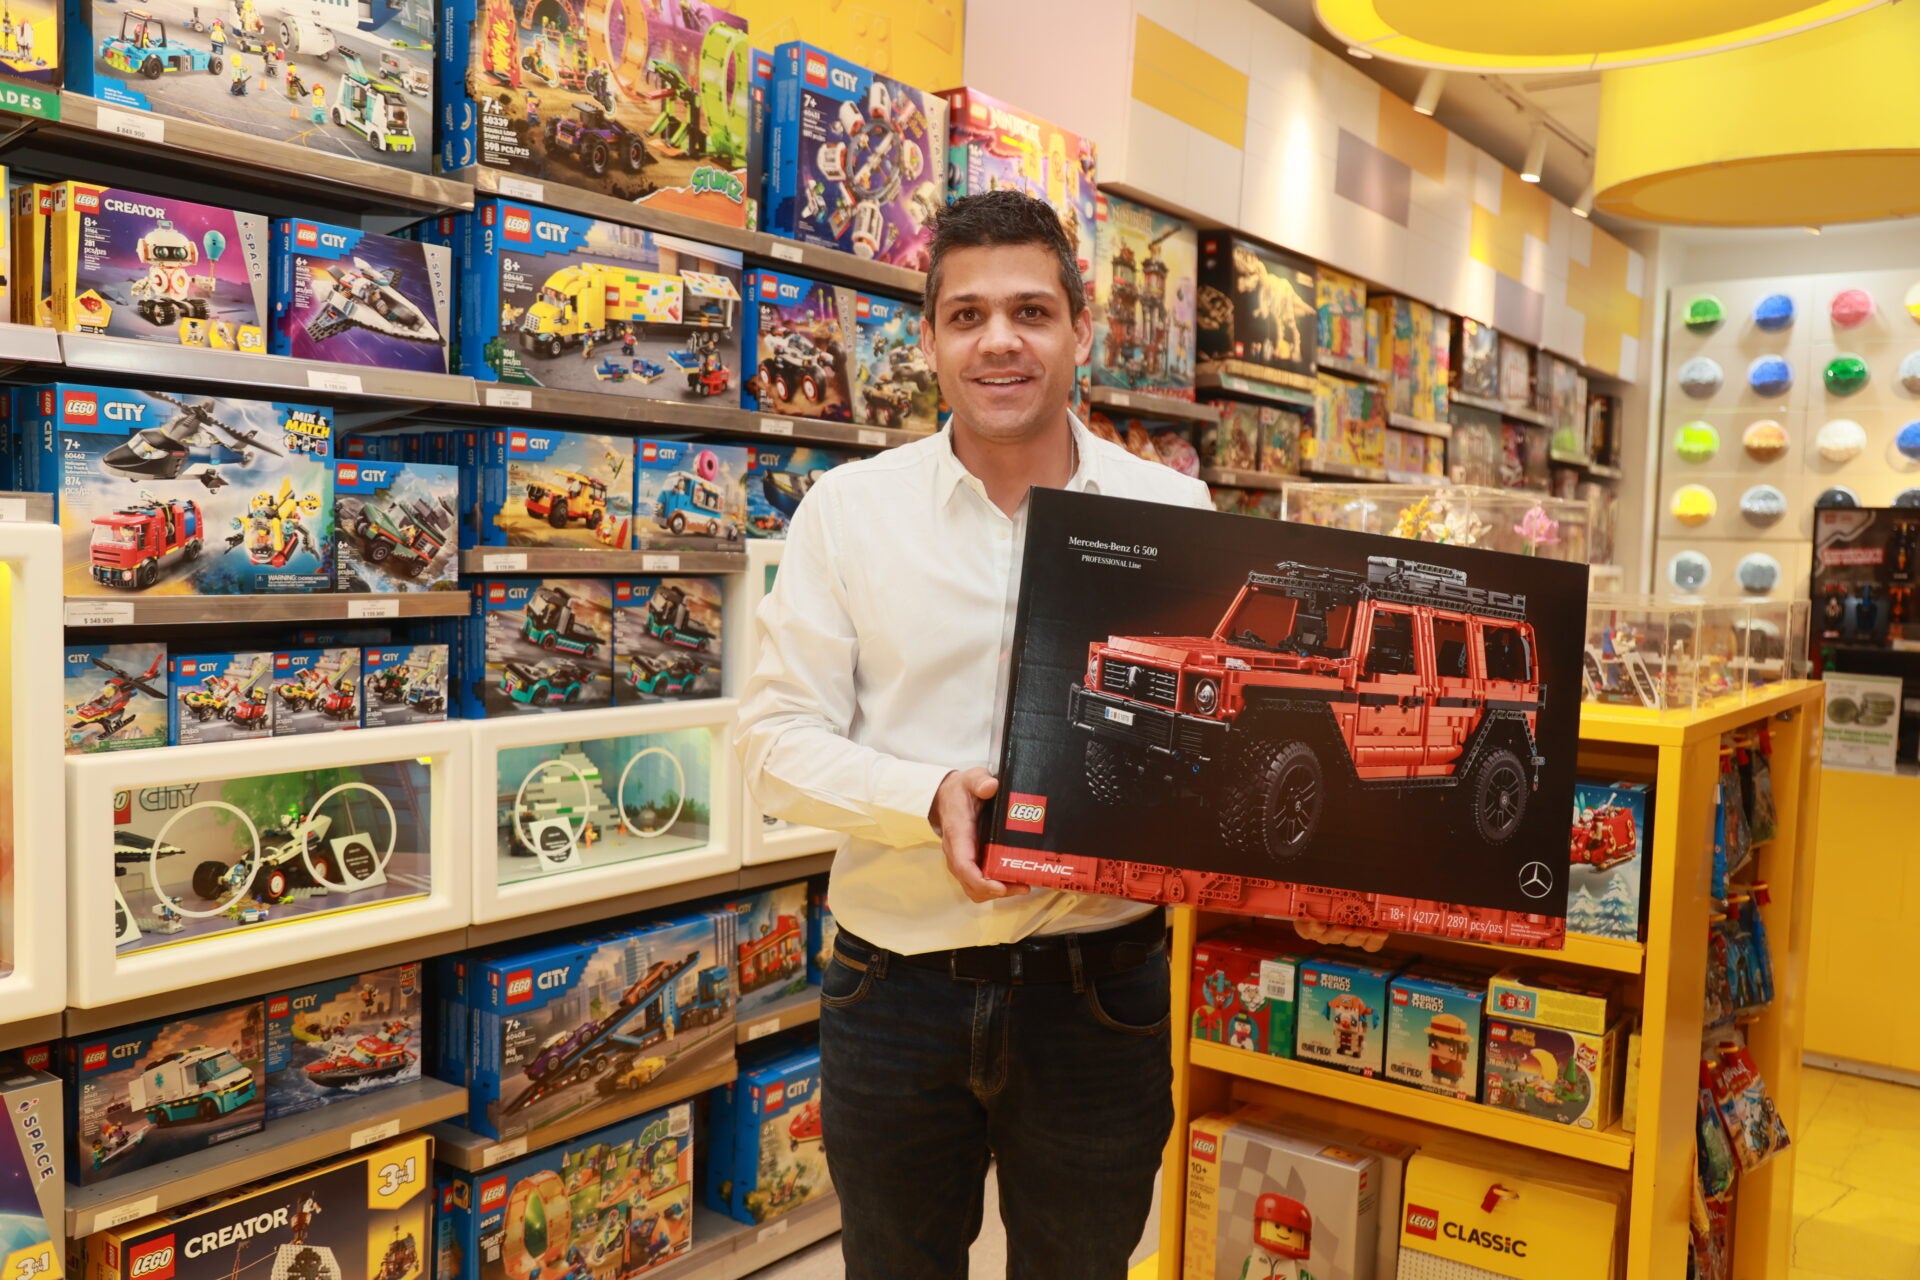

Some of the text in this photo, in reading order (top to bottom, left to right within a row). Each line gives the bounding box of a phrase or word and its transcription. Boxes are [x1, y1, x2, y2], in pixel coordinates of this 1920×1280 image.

[806, 59, 858, 92] LEGO CITY
[482, 96, 503, 114] 7+
[804, 94, 817, 108] 7+
[484, 142, 500, 152] 598
[75, 194, 165, 219] LEGO CREATOR
[84, 217, 98, 227] 8+
[506, 217, 570, 243] LEGO CITY
[298, 230, 348, 249] LEGO CITY
[484, 229, 493, 255] CITY
[244, 233, 262, 280] SPACE
[296, 257, 308, 266] 6+
[503, 258, 520, 271] 8+
[780, 283, 799, 299] CITY
[760, 306, 770, 314] 6+
[872, 304, 889, 318] CITY
[65, 400, 146, 422] LEGO CITY
[293, 411, 316, 425] MIX
[285, 420, 330, 437] MATCH
[44, 420, 53, 453] CITY
[530, 438, 550, 449] CITY
[64, 439, 80, 450] 7+
[659, 449, 677, 460] CITY
[760, 454, 780, 466] CITY
[65, 477, 81, 485] 874
[338, 468, 387, 482] LEGO CITY
[338, 541, 348, 549] 6+
[1069, 536, 1157, 556] Mercedes-Benz G 500
[1082, 555, 1141, 569] PROFESSIONAL Line
[509, 588, 528, 599] CITY
[633, 585, 650, 596] CITY
[68, 654, 89, 664] CITY
[292, 656, 309, 665] CITY
[383, 653, 399, 661] CITY
[199, 663, 217, 672] CITY
[138, 782, 199, 811] CITY
[1009, 803, 1044, 822] LEGO
[1000, 857, 1074, 876] TECHNIC
[1390, 908, 1503, 934] 18+ 42177 2891 pcs/pzs
[508, 966, 570, 995] LEGO CITY
[270, 994, 318, 1013] LEGO CITY
[506, 1020, 520, 1032] 7+
[1489, 1041, 1498, 1049] 6+
[27, 1053, 47, 1064] LEGO
[85, 1041, 143, 1065] LEGO CITY
[84, 1084, 96, 1094] 5+
[787, 1079, 810, 1098] CITY
[24, 1115, 56, 1180] SPACE
[1194, 1140, 1215, 1153] LEGO
[1191, 1162, 1207, 1174] 10+
[484, 1185, 505, 1202] LEGO
[1409, 1214, 1435, 1230] LEGO
[132, 1206, 288, 1277] LEGO CREATOR
